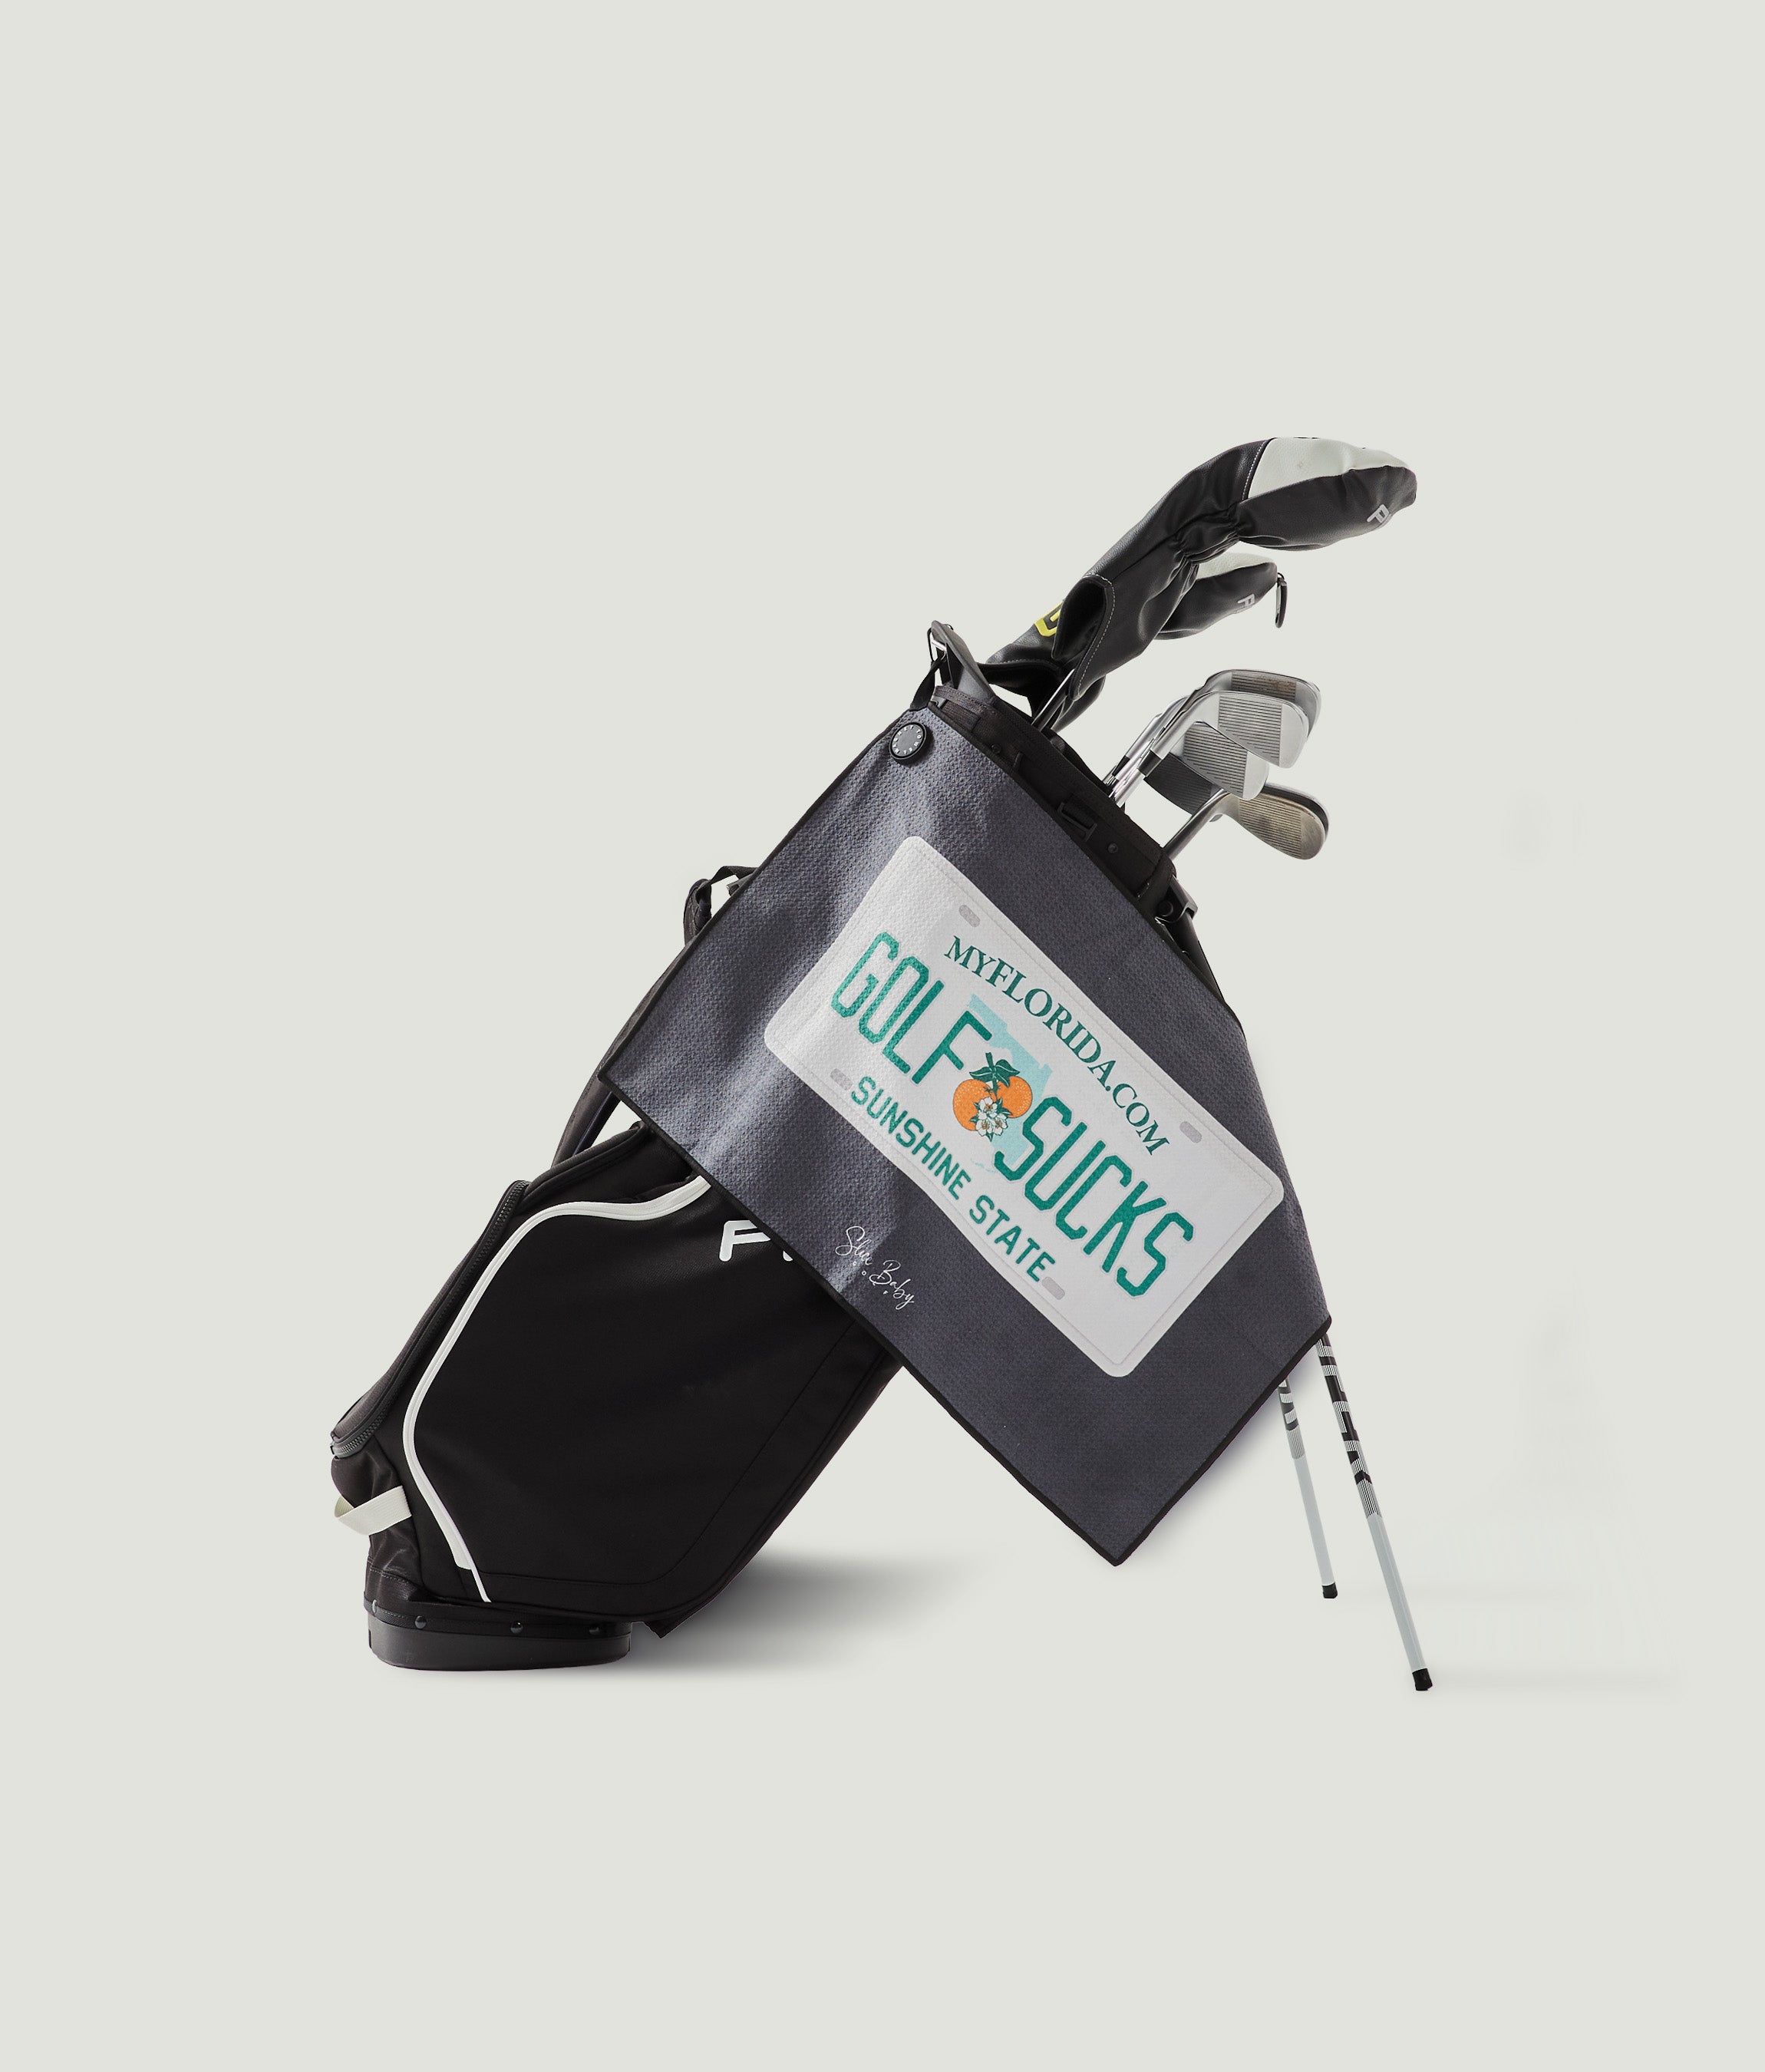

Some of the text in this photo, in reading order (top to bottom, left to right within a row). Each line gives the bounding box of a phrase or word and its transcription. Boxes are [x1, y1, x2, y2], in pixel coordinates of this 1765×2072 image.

[830, 932, 1194, 1298] GOLF SUCKS
[942, 935, 1171, 1156] MYFLORIDA.COM
[835, 1226, 915, 1310] Slice Baby
[850, 1075, 1057, 1282] SUNSHINE STATE
